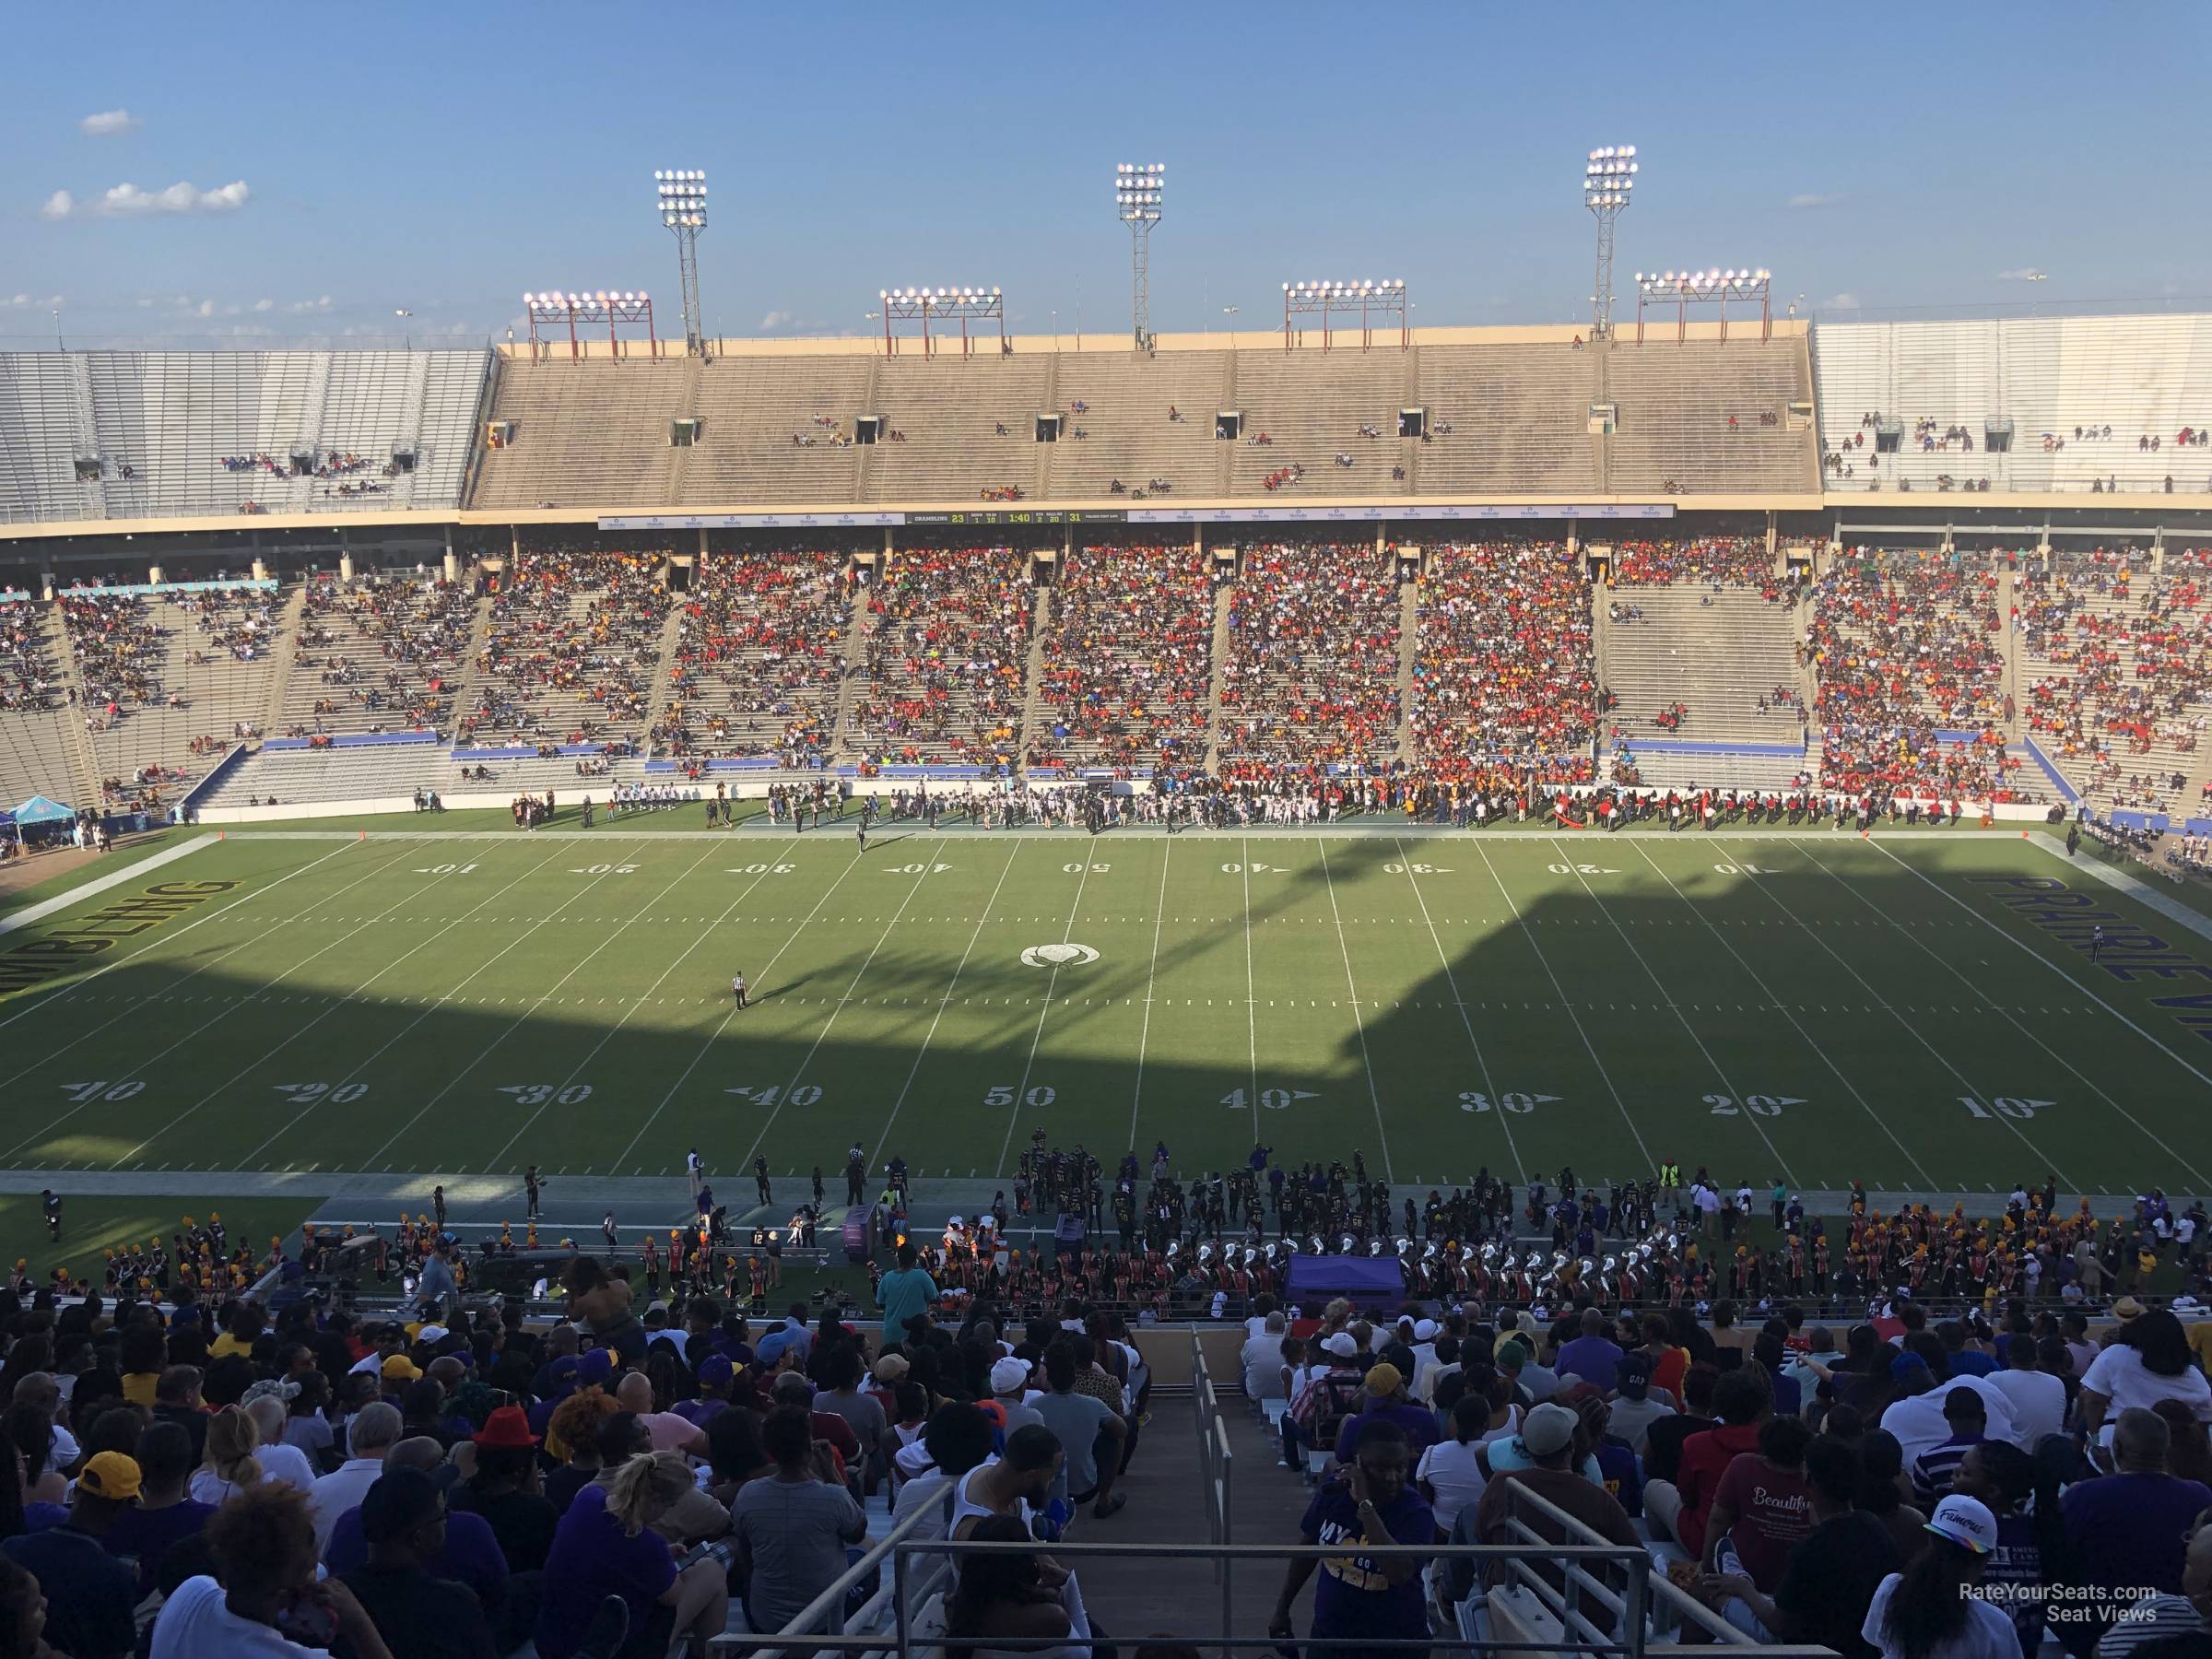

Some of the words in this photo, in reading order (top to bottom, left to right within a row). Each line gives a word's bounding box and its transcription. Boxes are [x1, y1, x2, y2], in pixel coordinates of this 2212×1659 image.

[952, 514, 964, 524] 23
[1009, 513, 1030, 523] 1:40
[1069, 513, 1081, 522] 31
[68, 1081, 147, 1100] 10
[287, 1083, 370, 1103] 20
[515, 1085, 594, 1104] 30
[748, 1086, 823, 1105] 40
[983, 1086, 1056, 1106] 50
[1219, 1088, 1290, 1109] 40
[1458, 1092, 1534, 1112] 30
[1702, 1095, 1782, 1115] 20
[1956, 1097, 2034, 1118] 10
[754, 1233, 763, 1244] 12
[1630, 1374, 1645, 1385] GAP
[1753, 1486, 1811, 1513] Beautifu
[1939, 1509, 1984, 1534] Famous
